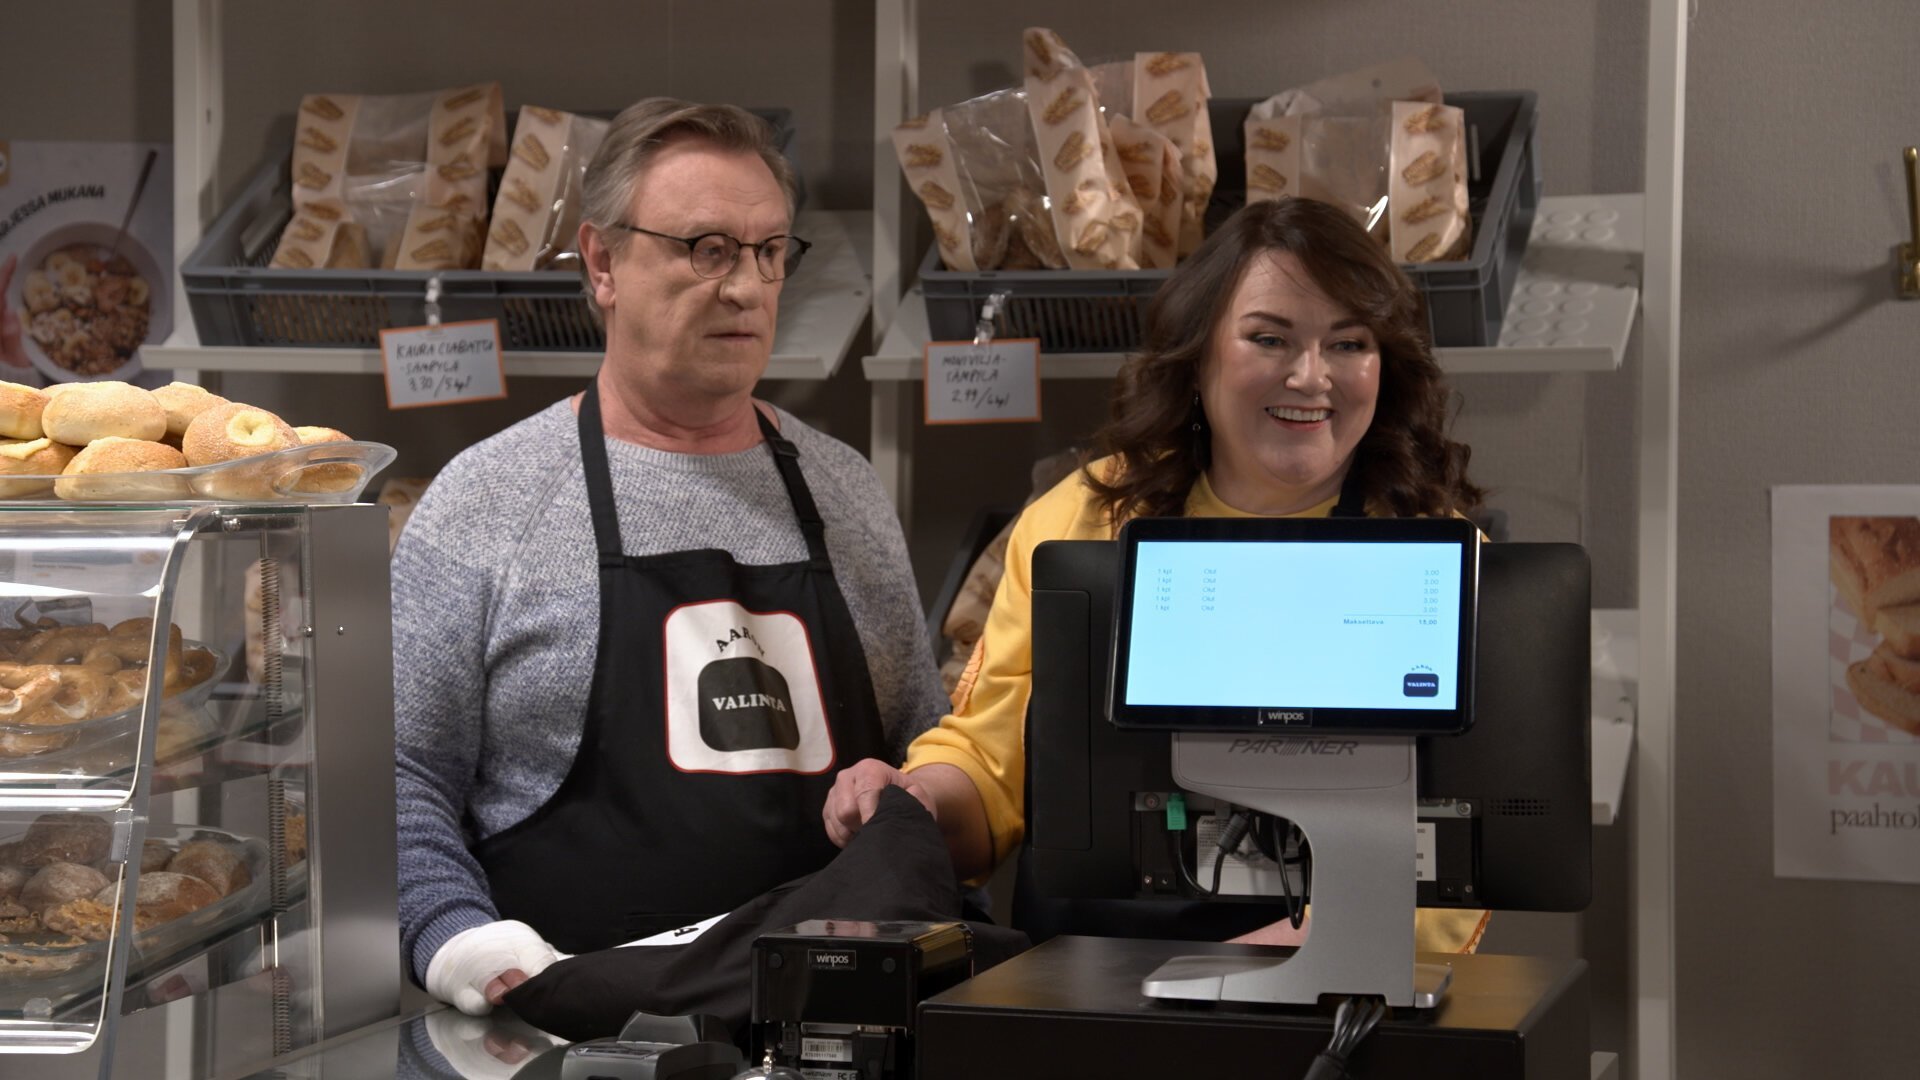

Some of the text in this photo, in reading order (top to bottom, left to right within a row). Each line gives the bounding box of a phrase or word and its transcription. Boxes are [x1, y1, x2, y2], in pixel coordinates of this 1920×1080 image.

[47, 185, 105, 204] MUKANA
[712, 693, 787, 712] VALINTA
[1268, 710, 1304, 725] winpos
[816, 953, 849, 967] winpos
